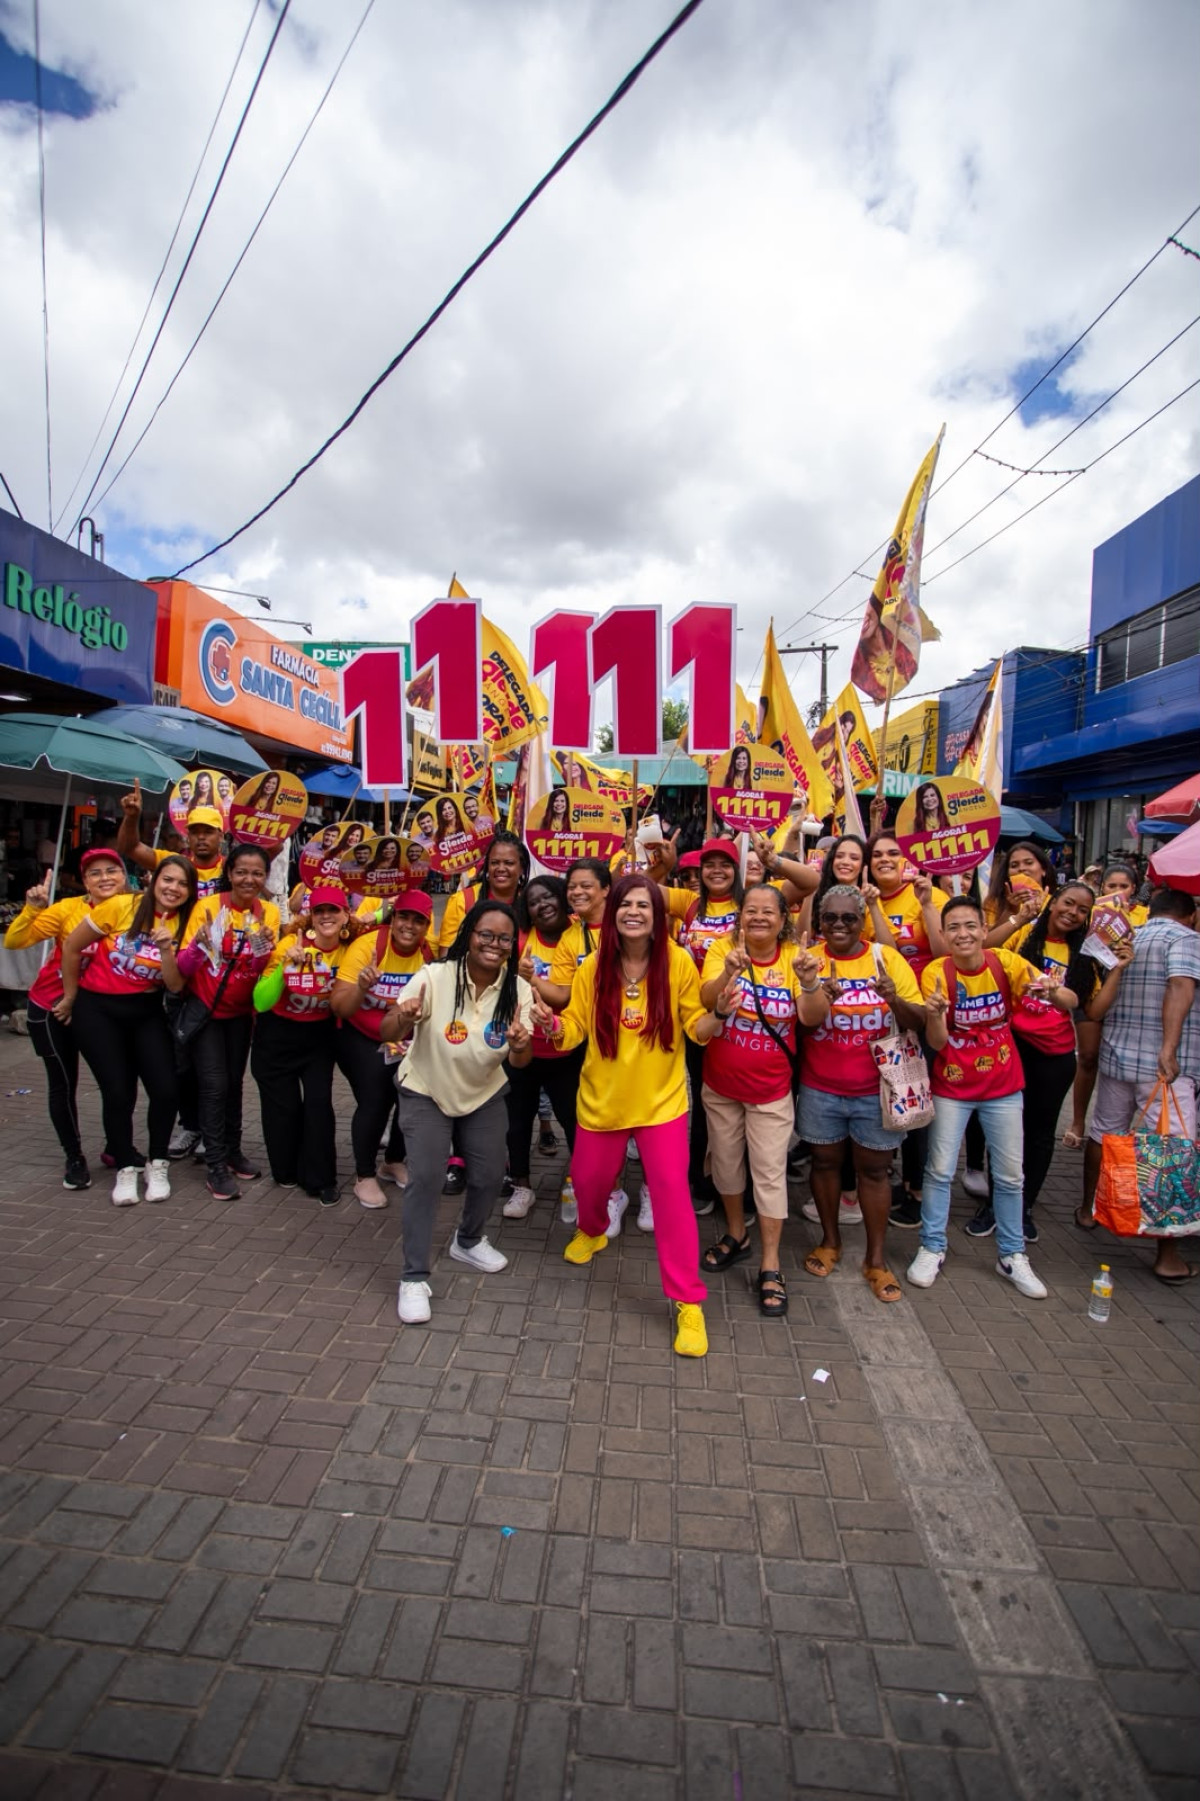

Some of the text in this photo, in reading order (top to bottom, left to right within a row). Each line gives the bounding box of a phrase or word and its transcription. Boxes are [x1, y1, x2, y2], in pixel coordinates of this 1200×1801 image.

[4, 562, 128, 651] Relógio
[313, 649, 358, 661] DEN
[240, 656, 294, 711] SANTA
[340, 647, 407, 789] 1
[410, 598, 481, 745] 1
[587, 605, 661, 757] 1
[667, 602, 736, 754] 1
[489, 651, 535, 725] DELEGADA
[753, 767, 785, 781] gleide
[572, 809, 604, 823] gleide
[717, 796, 780, 819] 11111
[948, 795, 986, 816] gleide
[233, 813, 291, 839] 11111
[533, 838, 600, 857] 11111
[909, 829, 990, 862] 11111
[766, 989, 790, 1002] DA
